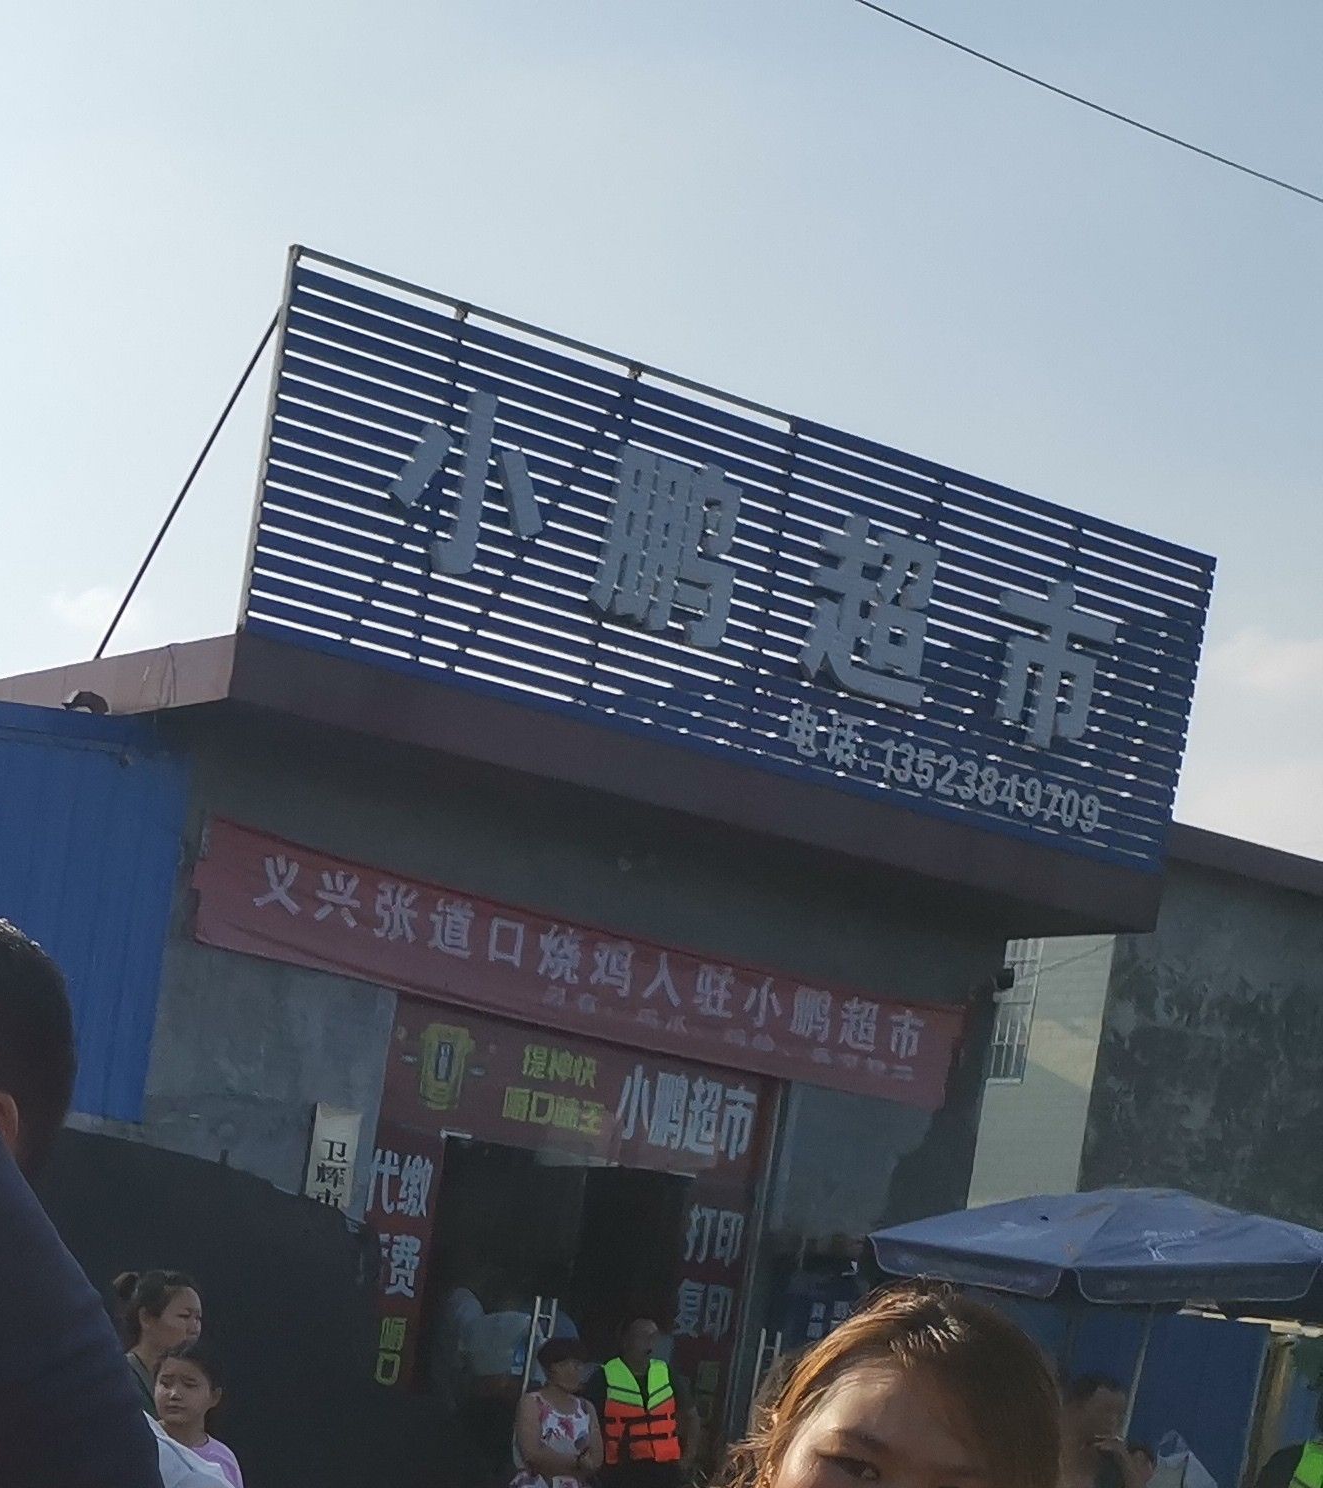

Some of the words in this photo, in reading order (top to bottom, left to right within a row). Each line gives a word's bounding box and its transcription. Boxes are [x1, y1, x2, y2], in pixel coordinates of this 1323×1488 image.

[387, 389, 1117, 748] 小鹏超市
[615, 1066, 758, 1163] 小鹏超市
[366, 1148, 434, 1217] 代缴
[684, 1204, 745, 1267] 打印
[673, 1279, 735, 1342] 复印
